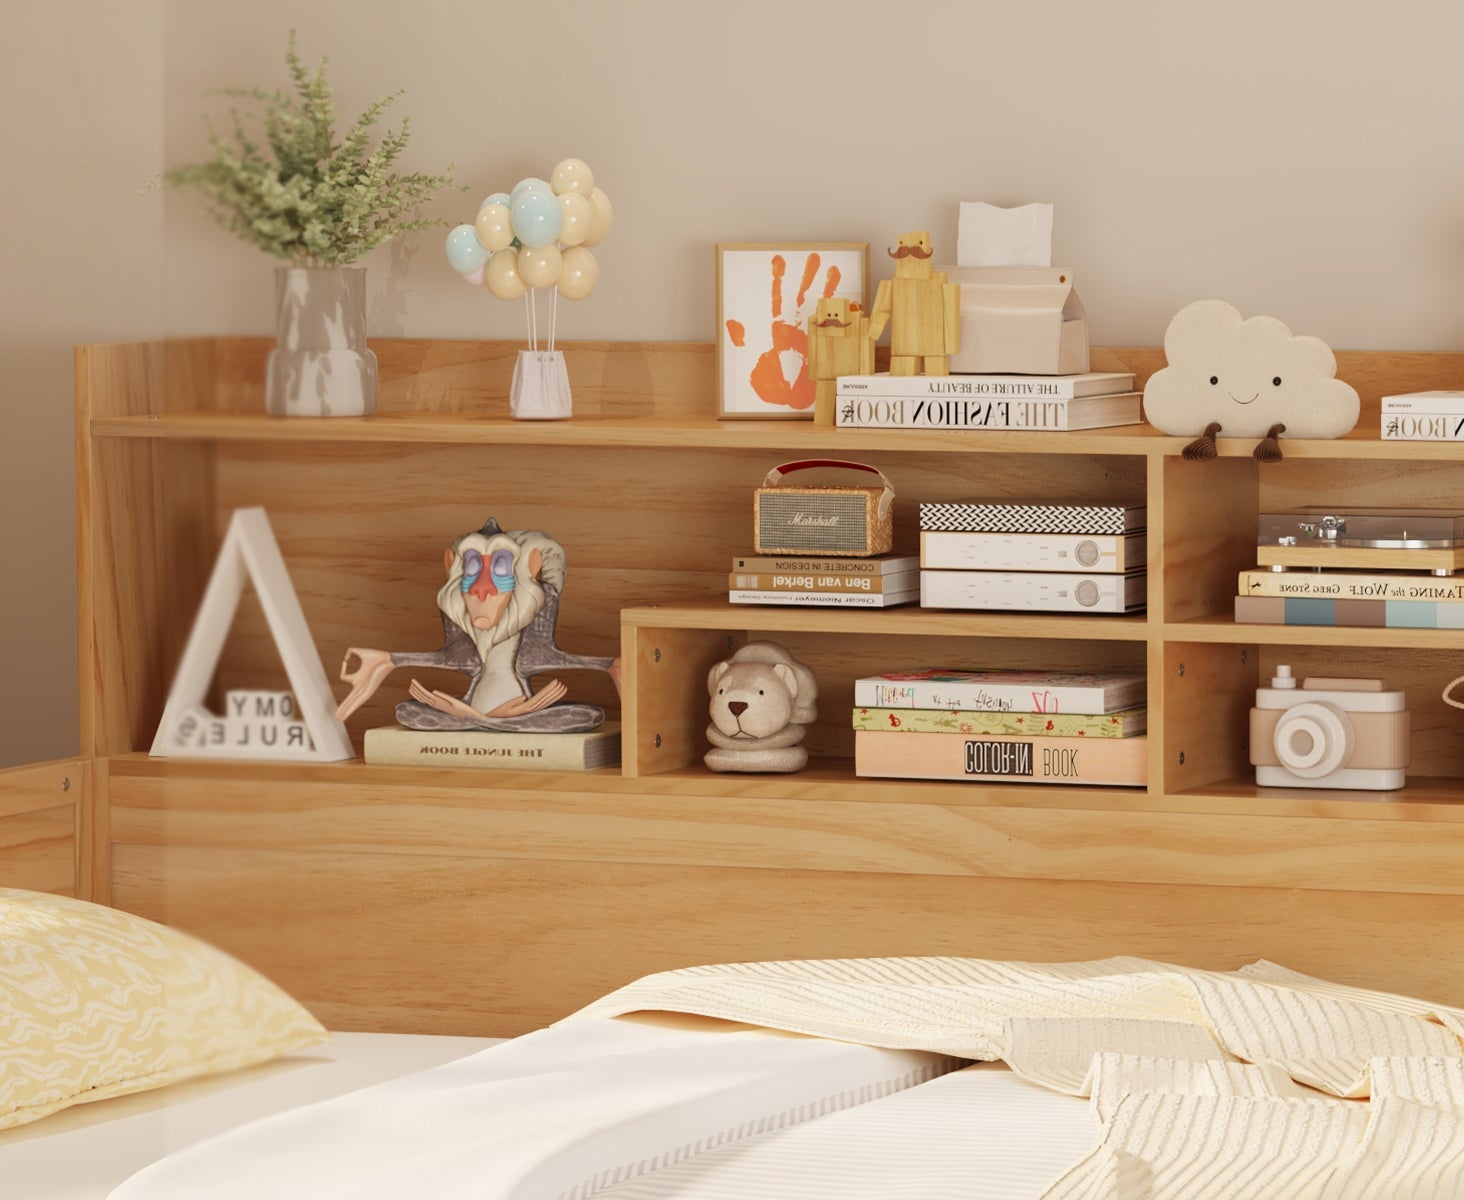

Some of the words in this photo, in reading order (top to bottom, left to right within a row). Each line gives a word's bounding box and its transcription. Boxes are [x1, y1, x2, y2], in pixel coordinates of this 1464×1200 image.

[927, 382, 972, 393] BEAUTY
[974, 383, 990, 394] OF
[992, 383, 1033, 394] ALLURE
[1037, 384, 1061, 395] THE
[787, 511, 840, 527] Marshall
[775, 562, 811, 571] DESIGN
[812, 562, 821, 571] IN
[824, 562, 874, 572] CONCRETE
[773, 575, 814, 589] Berkel
[817, 577, 841, 588] van
[846, 577, 871, 590] Ben
[795, 595, 842, 604] Niemeyer
[846, 597, 875, 605] Oscar
